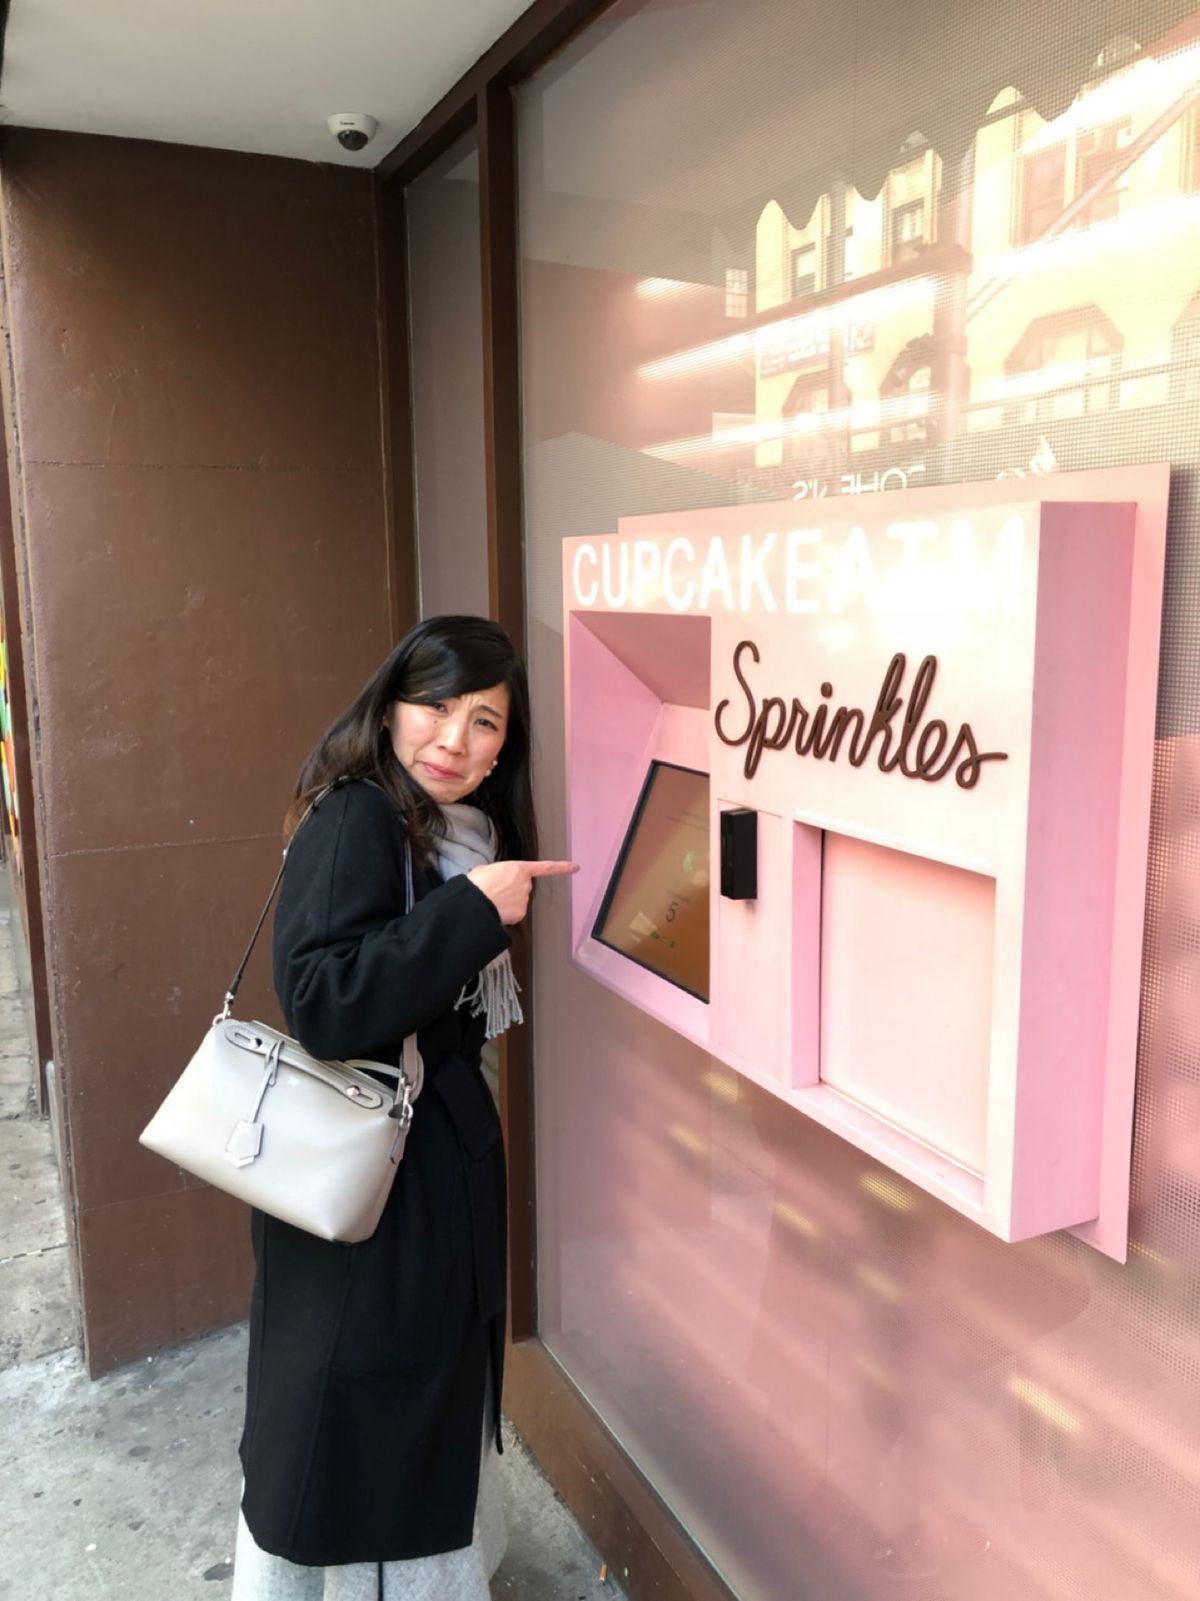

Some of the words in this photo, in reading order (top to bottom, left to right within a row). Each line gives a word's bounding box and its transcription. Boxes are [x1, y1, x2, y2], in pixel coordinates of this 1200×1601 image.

[572, 528, 823, 614] CUPCAKE
[827, 514, 1025, 616] ATM
[715, 639, 1009, 789] Sprinkles
